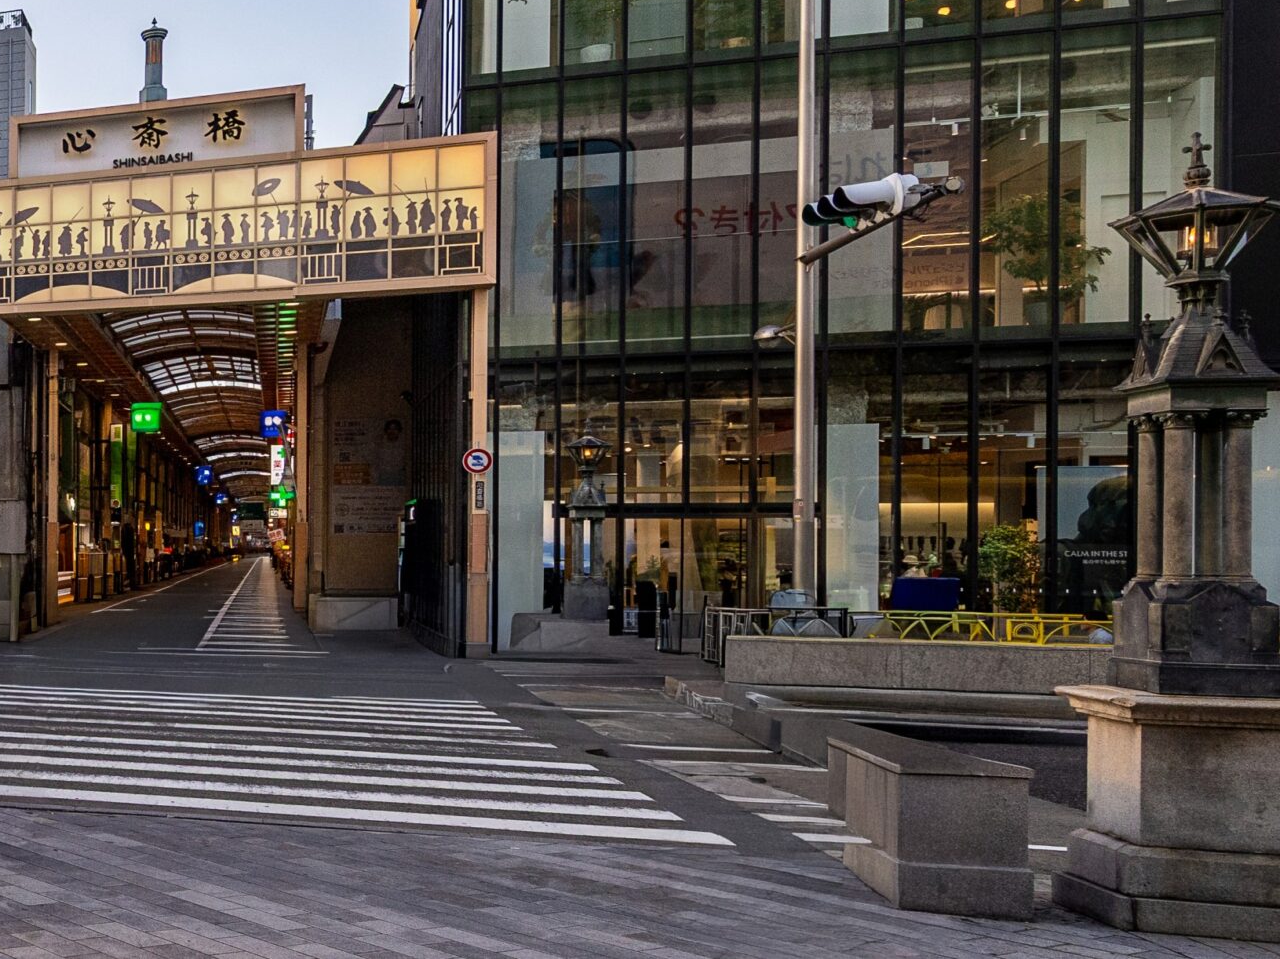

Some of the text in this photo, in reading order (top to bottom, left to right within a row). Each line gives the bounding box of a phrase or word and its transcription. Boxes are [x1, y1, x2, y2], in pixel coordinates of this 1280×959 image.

[113, 151, 193, 169] SHINSAIBASHI
[1064, 550, 1089, 558] CALM
[1090, 550, 1100, 558] IN
[1101, 550, 1117, 558] THE
